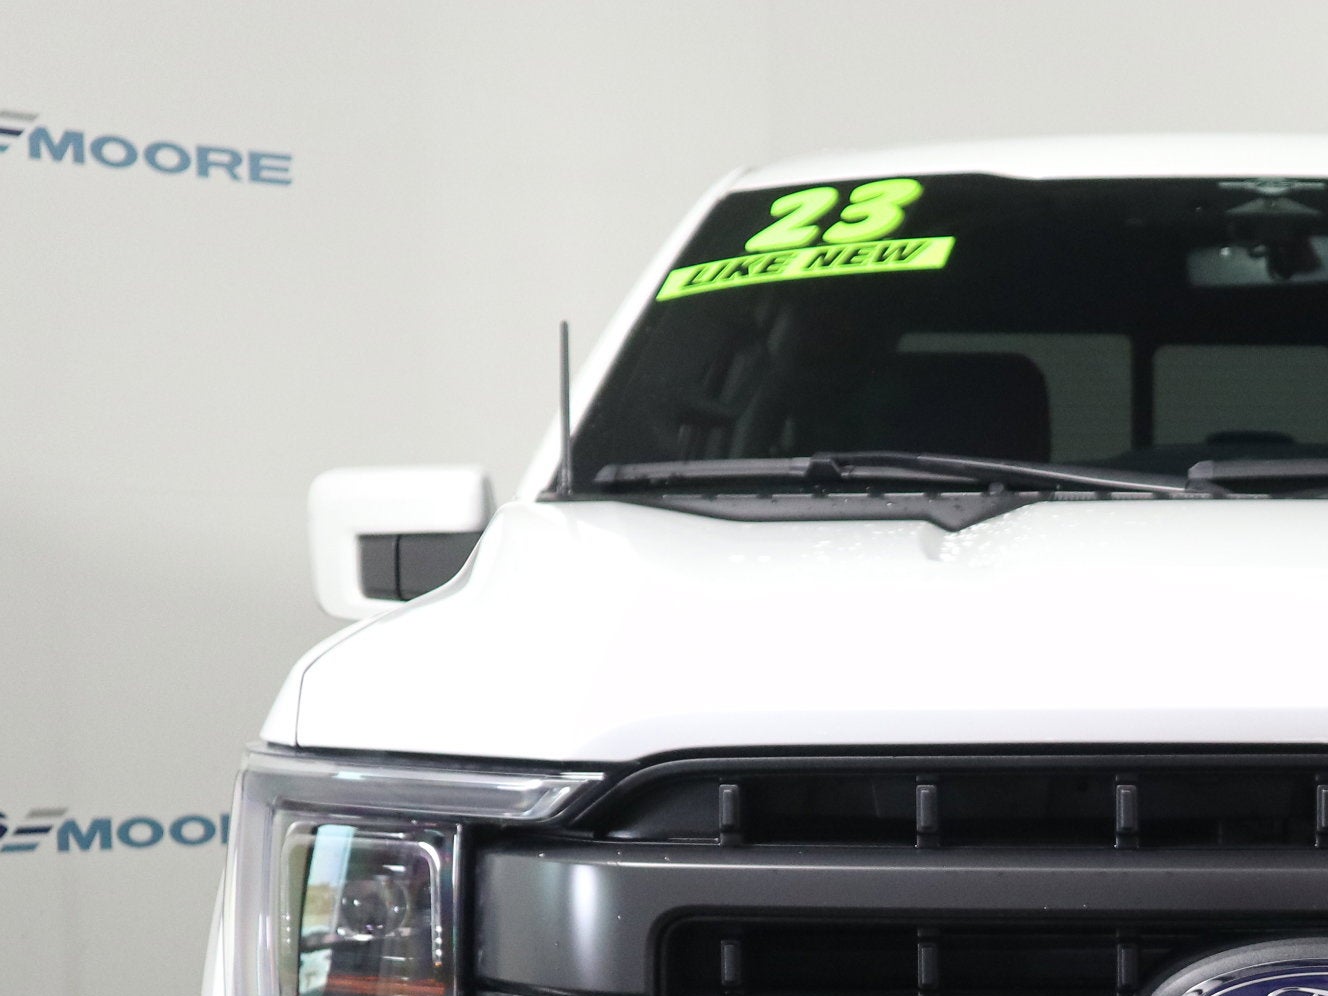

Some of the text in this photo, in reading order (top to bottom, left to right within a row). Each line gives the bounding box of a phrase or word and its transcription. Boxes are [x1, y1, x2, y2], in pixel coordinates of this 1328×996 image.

[27, 126, 293, 185] MOORE
[744, 178, 924, 252] 23
[682, 241, 928, 288] LIKE NEW
[56, 813, 230, 852] MOO
